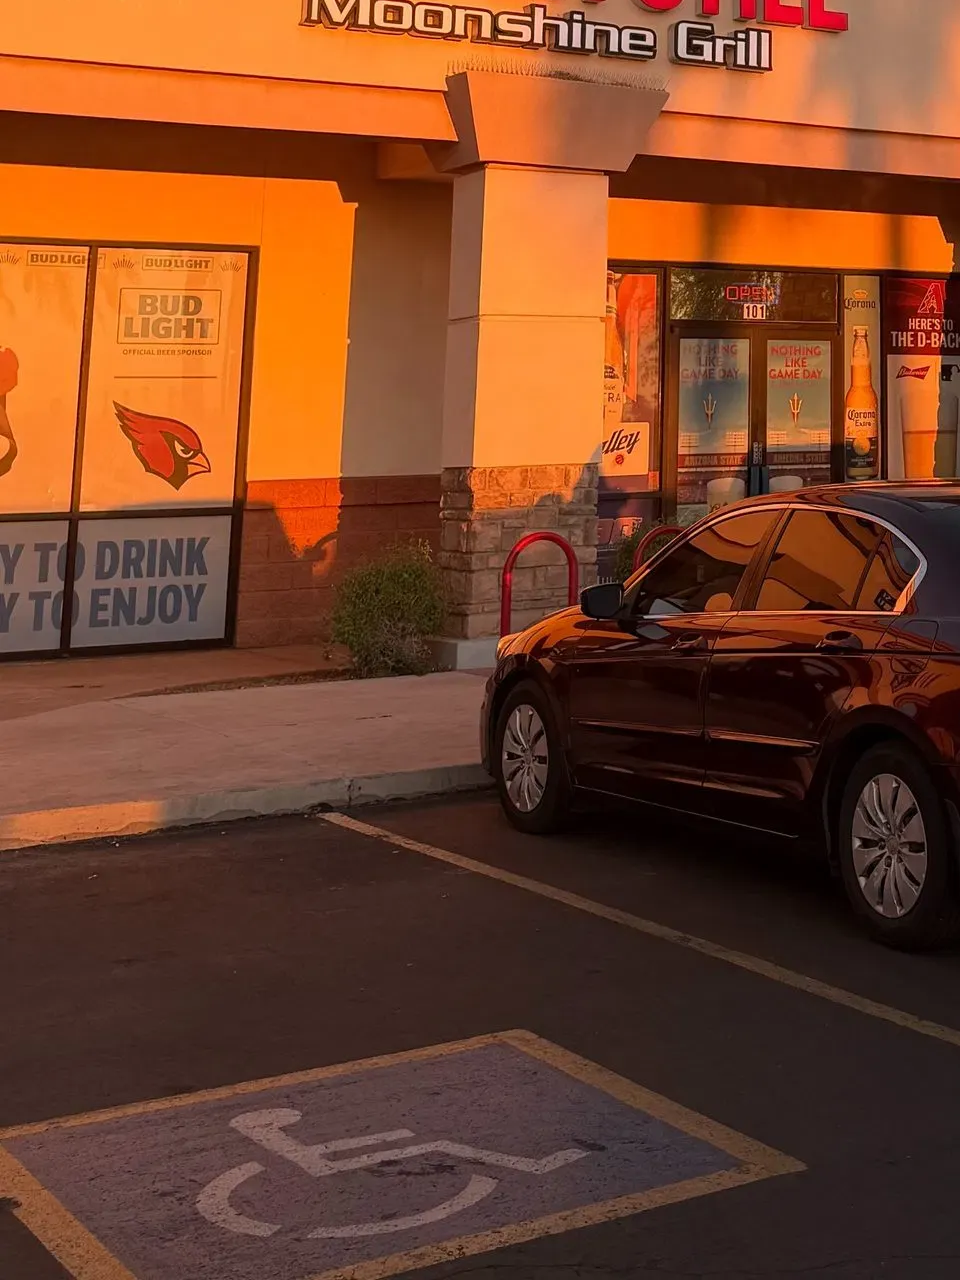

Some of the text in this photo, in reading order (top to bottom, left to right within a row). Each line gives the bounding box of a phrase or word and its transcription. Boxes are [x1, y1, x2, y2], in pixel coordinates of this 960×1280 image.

[669, 19, 773, 73] Grill
[30, 253, 103, 266] BUD LIG
[145, 258, 211, 269] BUD LIGHT
[726, 285, 776, 302] OPEN
[138, 294, 203, 317] BUD
[844, 297, 876, 311] Corona
[745, 304, 765, 319] 101
[123, 317, 214, 339] LIGHT
[908, 318, 954, 332] HERE'S TO
[890, 331, 915, 348] THE
[122, 348, 212, 357] OFFICIAL BEER SPONSOR
[683, 344, 739, 357] NOTHING
[770, 344, 822, 357] NOTHING
[698, 356, 725, 368] LIKE
[784, 357, 807, 368] LIKE
[680, 368, 740, 381] GAME DAY
[768, 368, 824, 380] GAME DAY
[847, 409, 876, 421] Corona
[684, 455, 743, 466] ARIZONA STATE
[34, 541, 86, 583] TO
[95, 536, 210, 581] DRINK
[29, 589, 80, 632] TO
[89, 583, 207, 628] ENJOY
